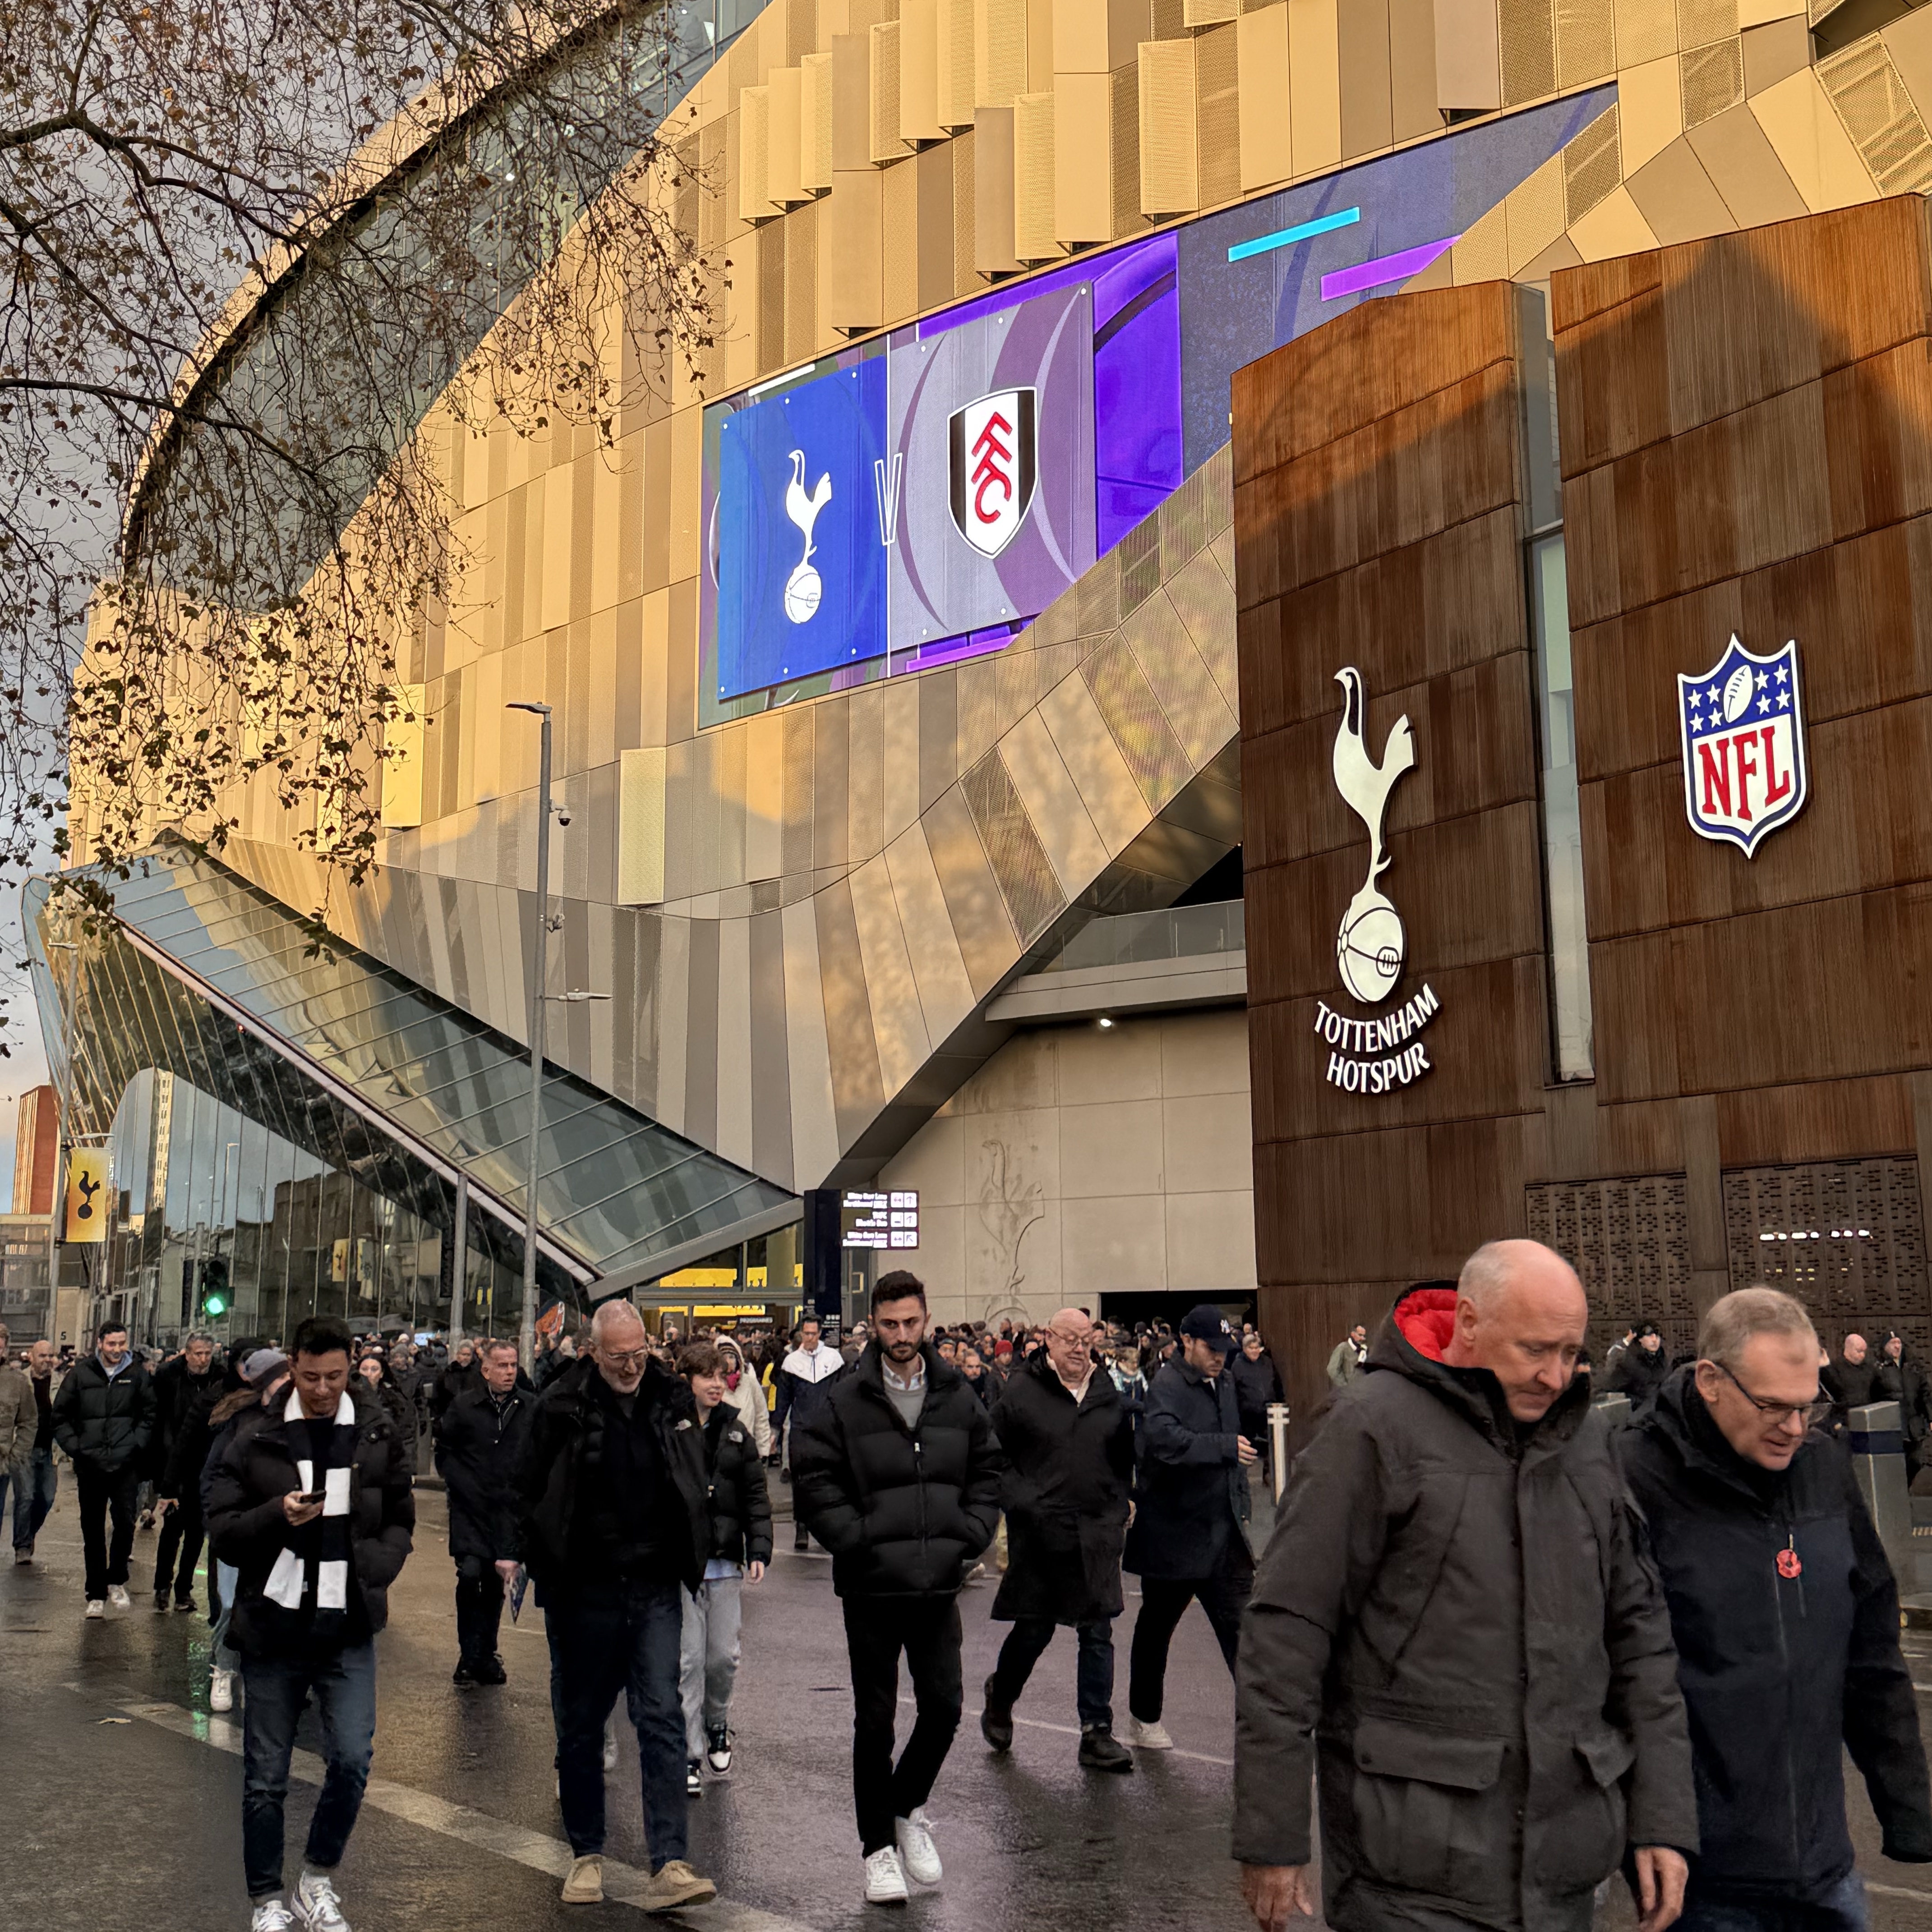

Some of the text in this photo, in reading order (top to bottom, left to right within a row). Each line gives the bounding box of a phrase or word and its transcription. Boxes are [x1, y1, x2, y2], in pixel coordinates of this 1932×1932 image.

[1698, 725, 1791, 822] NFL
[1314, 983, 1440, 1053] TOTTENHAM
[1326, 1042, 1430, 1093] HOTSPUR
